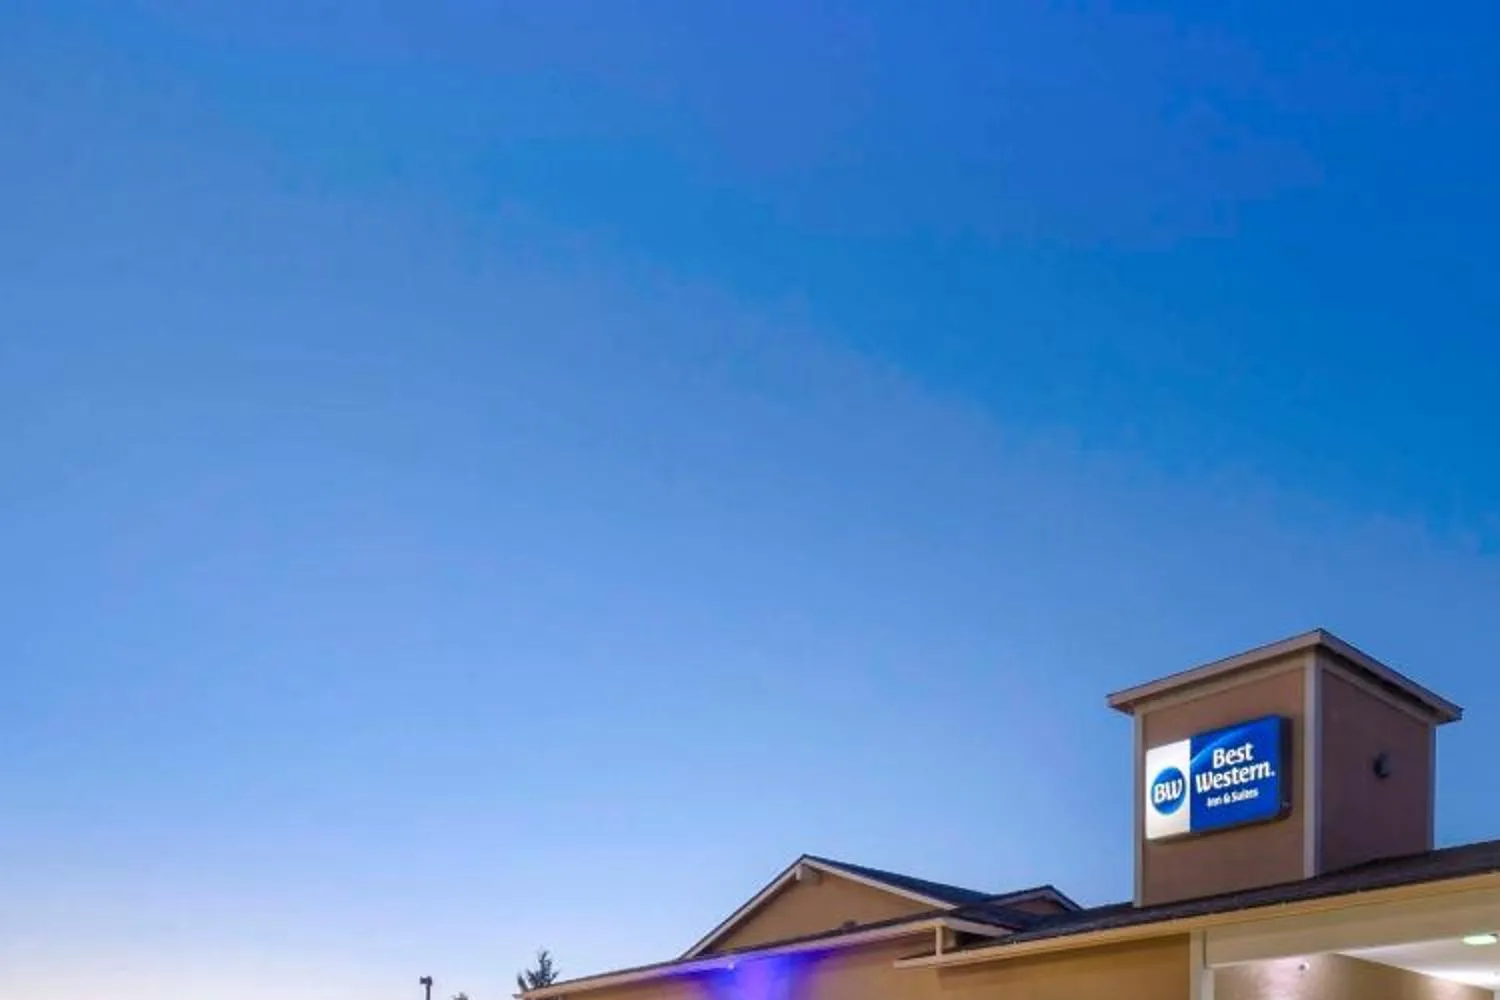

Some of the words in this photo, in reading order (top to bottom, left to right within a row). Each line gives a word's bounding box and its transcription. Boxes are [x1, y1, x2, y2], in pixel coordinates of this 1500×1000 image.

[1213, 742, 1254, 769] Best
[1154, 778, 1183, 804] BW
[1207, 797, 1222, 808] Inn
[1223, 792, 1231, 805] &
[1231, 787, 1259, 803] Suites
